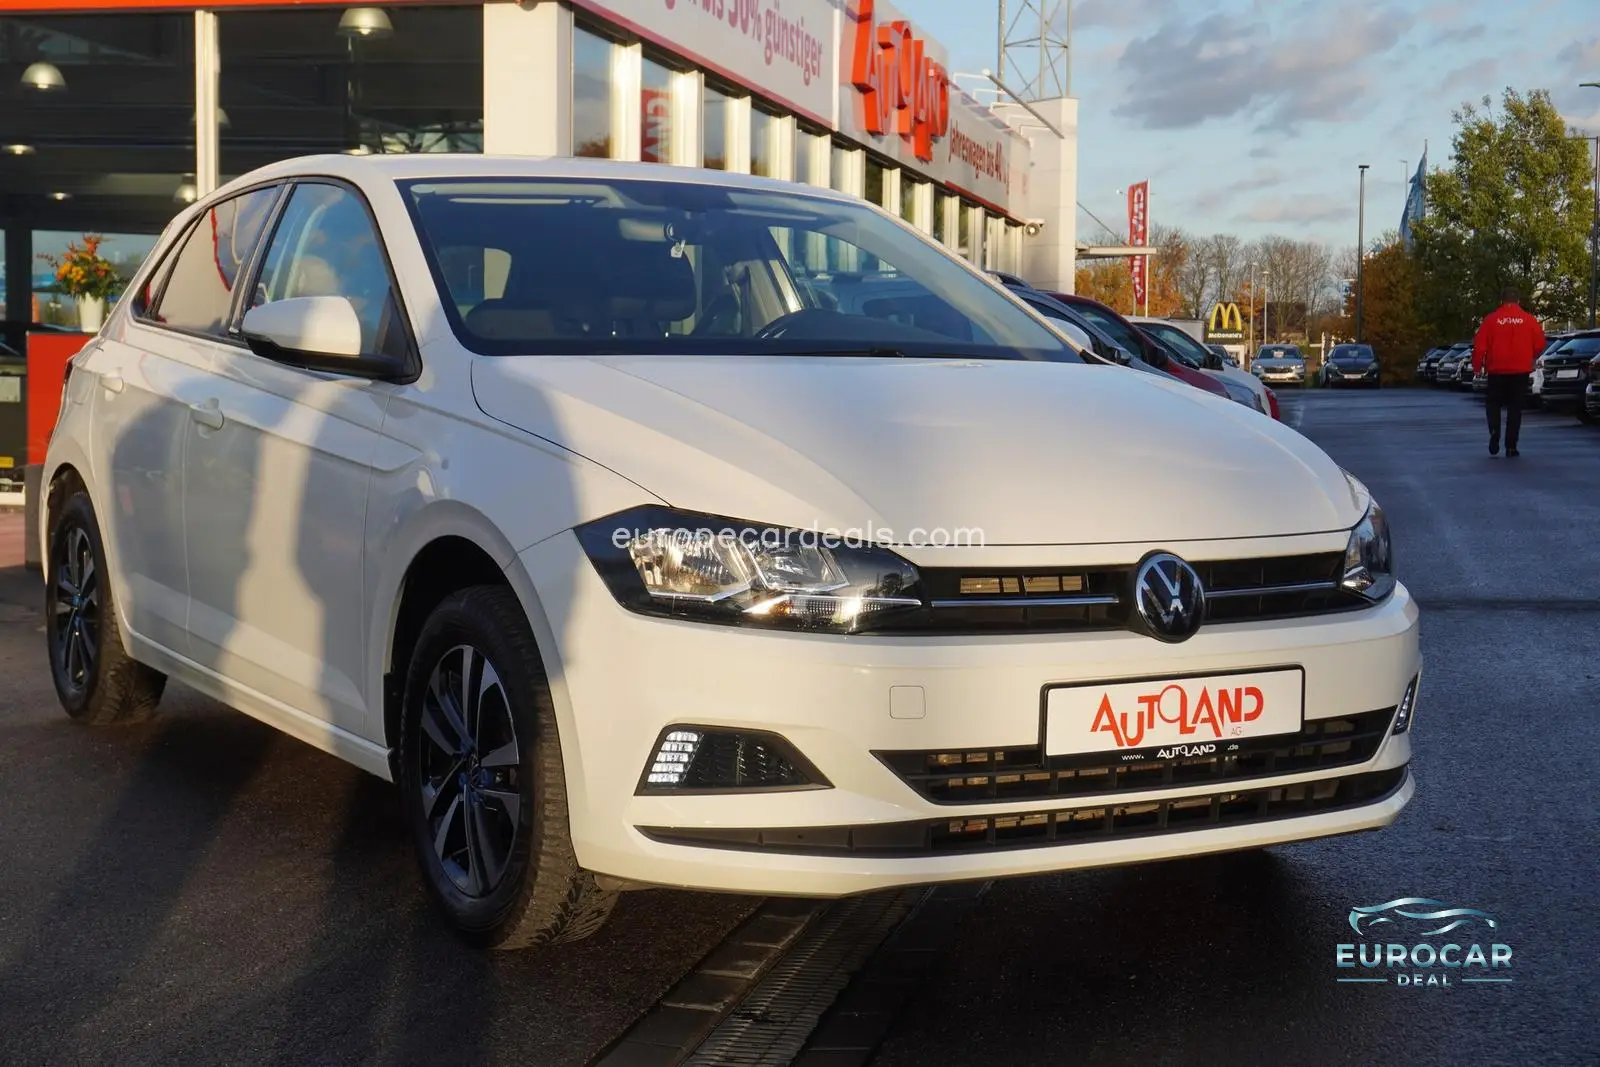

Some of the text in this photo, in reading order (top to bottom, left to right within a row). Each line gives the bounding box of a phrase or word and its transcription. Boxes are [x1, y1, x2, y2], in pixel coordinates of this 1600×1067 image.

[1231, 727, 1243, 737] AG
[1121, 752, 1145, 761] www.
[1227, 743, 1240, 752] .de
